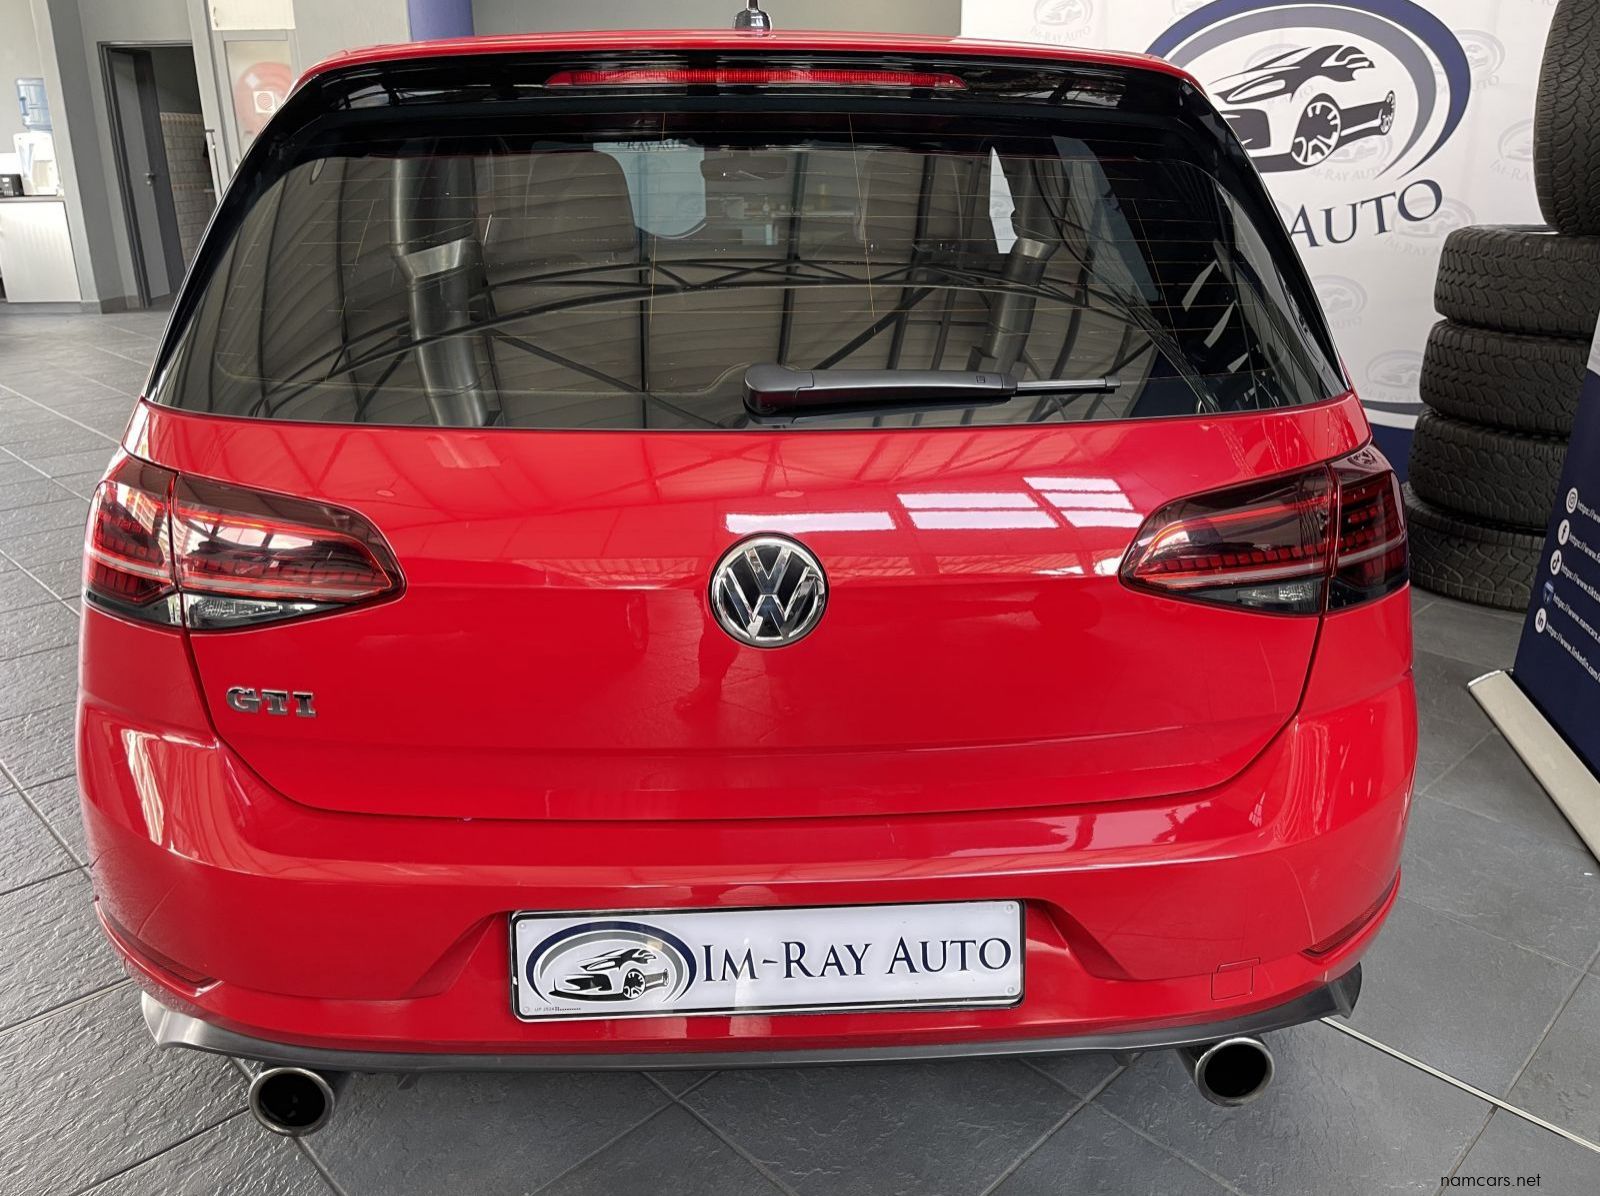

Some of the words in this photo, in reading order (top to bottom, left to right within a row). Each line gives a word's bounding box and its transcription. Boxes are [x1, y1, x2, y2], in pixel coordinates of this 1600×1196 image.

[1289, 179, 1443, 247] AUTO
[225, 686, 316, 718] GTI
[703, 941, 872, 983] IM-RAY
[887, 936, 1013, 975] AUTO
